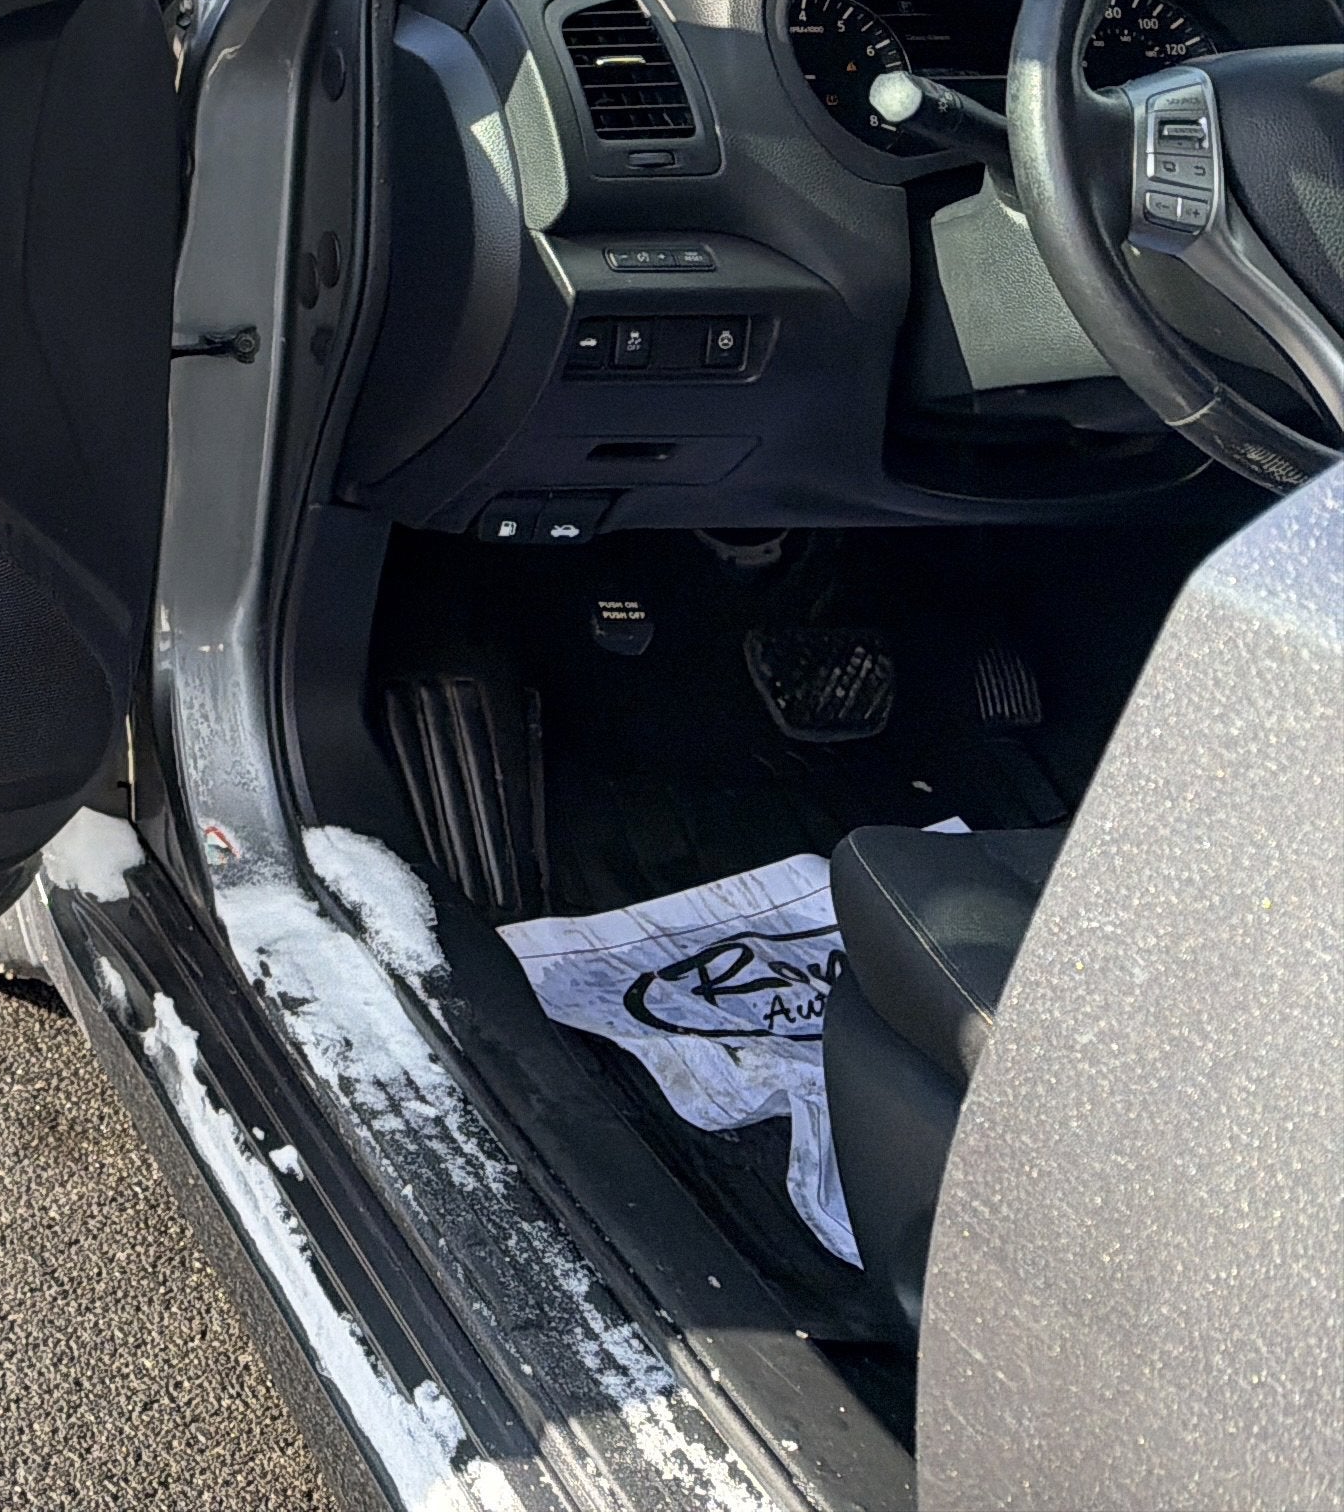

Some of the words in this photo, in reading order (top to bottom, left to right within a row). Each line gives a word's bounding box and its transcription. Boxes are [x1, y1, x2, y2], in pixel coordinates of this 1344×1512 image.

[798, 10, 807, 22] 4
[837, 19, 846, 33] 5
[1138, 18, 1159, 30] 100
[866, 44, 876, 57] 6
[1165, 44, 1192, 56] 120
[870, 114, 879, 127] 8
[597, 601, 624, 609] PUSH
[601, 610, 628, 620] PUSH
